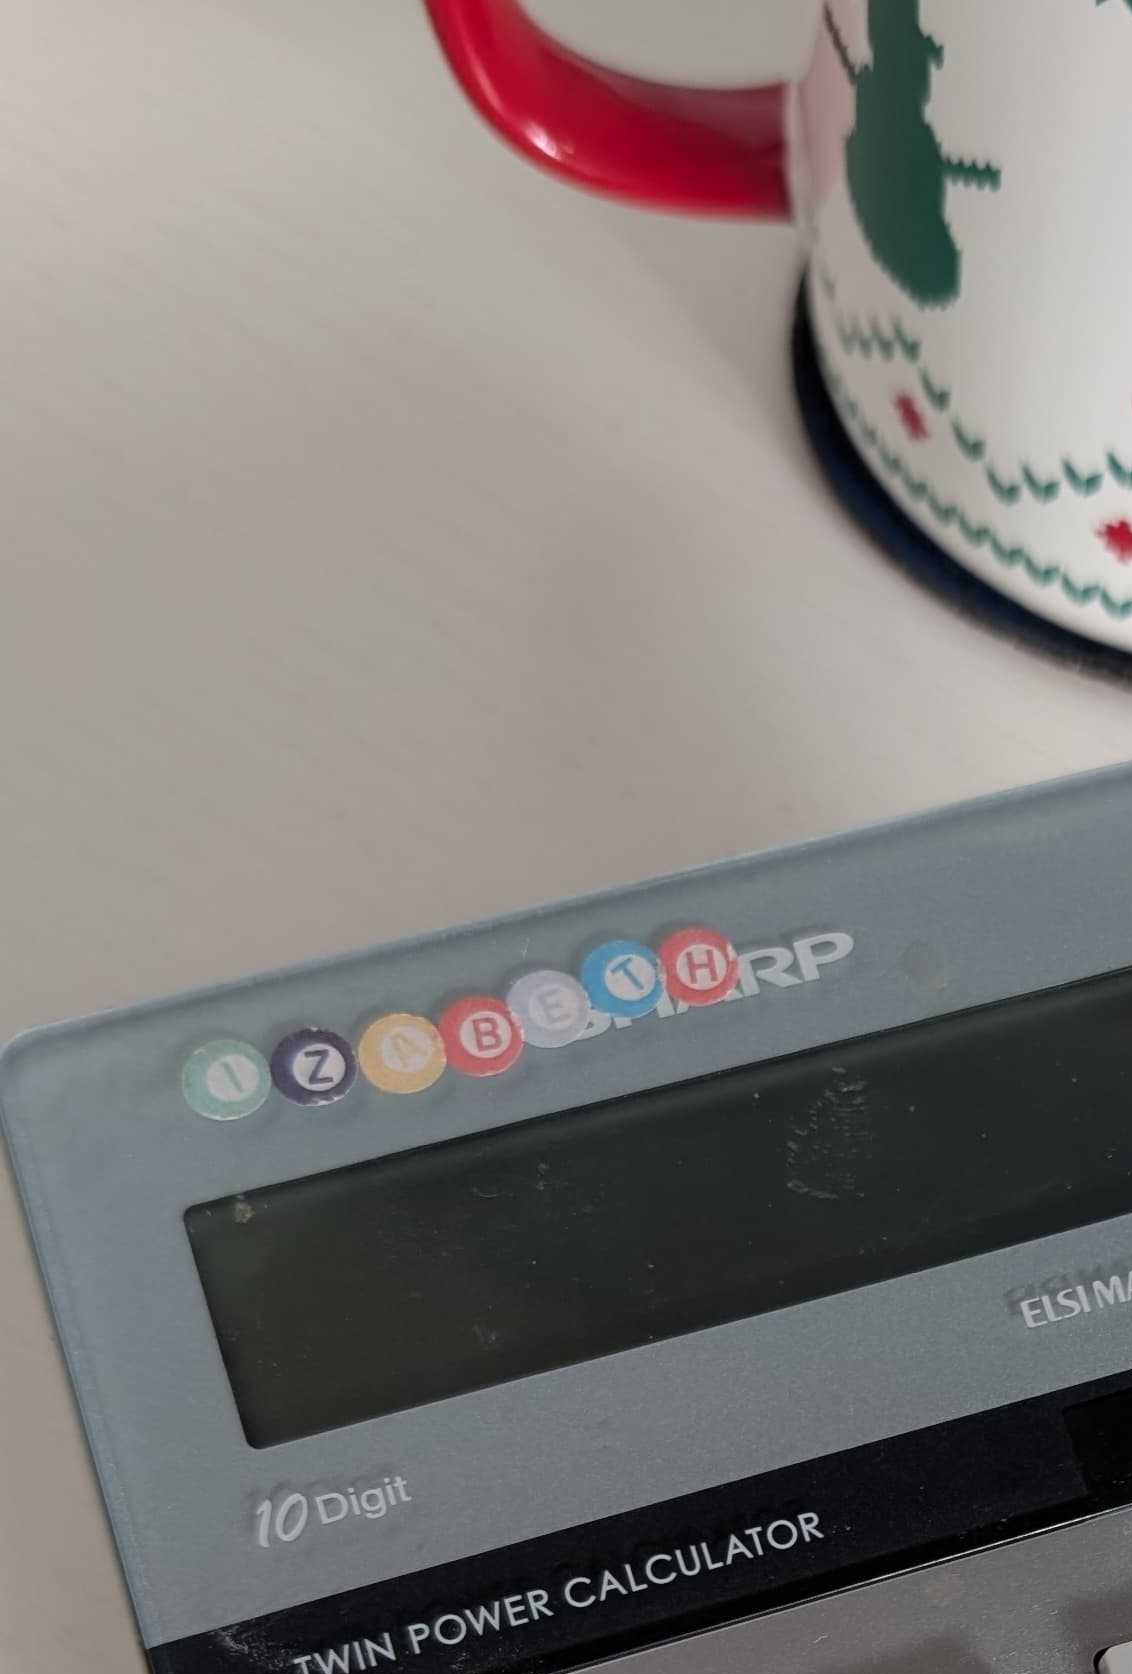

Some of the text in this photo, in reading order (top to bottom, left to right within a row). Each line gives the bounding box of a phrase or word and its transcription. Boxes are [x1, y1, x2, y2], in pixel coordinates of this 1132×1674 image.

[255, 1476, 412, 1547] 10 Digit
[409, 1590, 554, 1655] POWER
[564, 1512, 824, 1608] CALCULATOR
